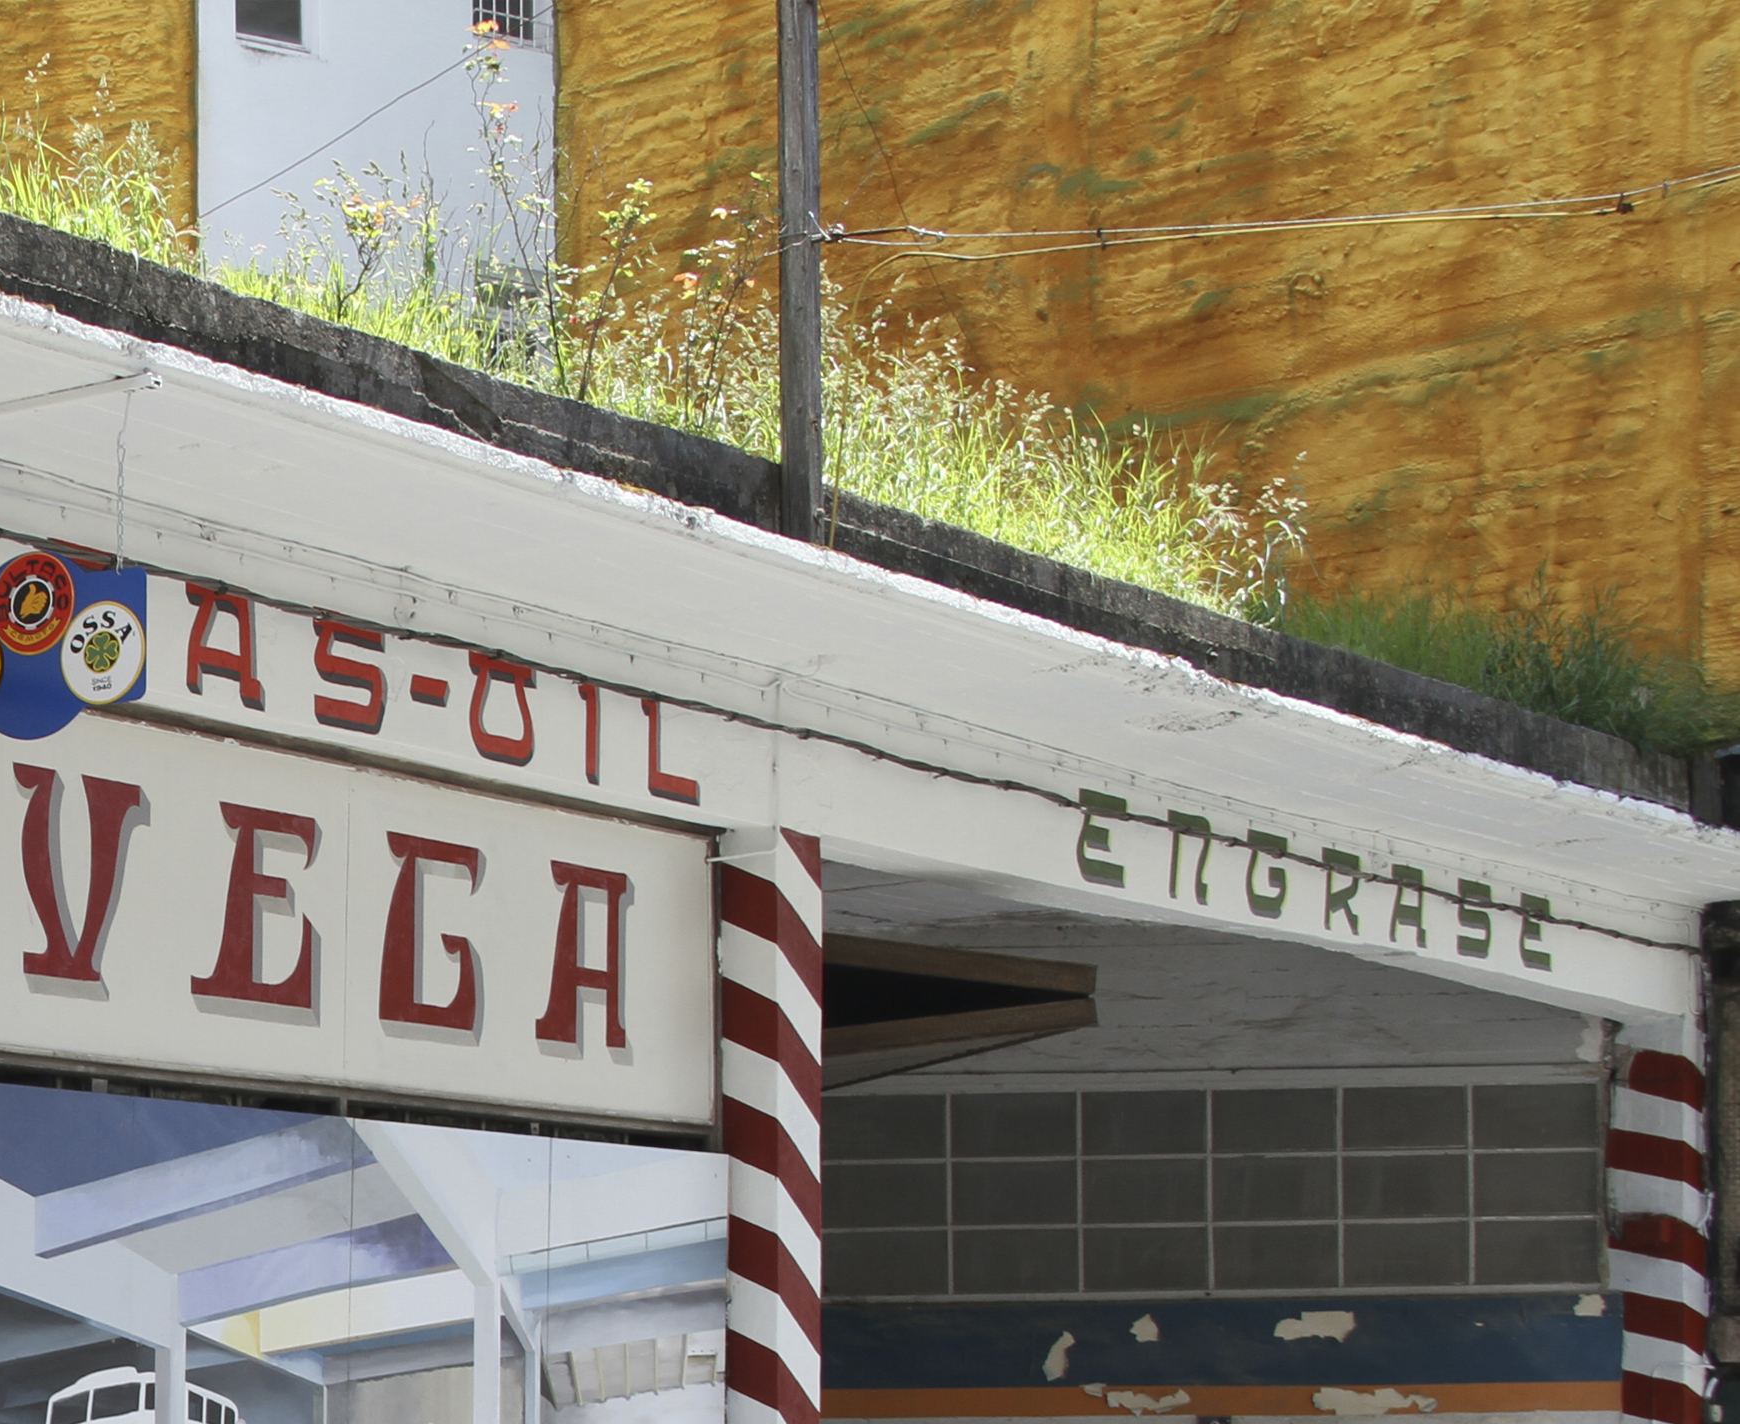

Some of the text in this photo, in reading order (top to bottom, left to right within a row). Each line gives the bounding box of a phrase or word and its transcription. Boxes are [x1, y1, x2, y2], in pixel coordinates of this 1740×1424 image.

[70, 610, 132, 654] OSSA
[12, 762, 633, 1065] VEGA
[1076, 788, 1551, 971] ENGRASE
